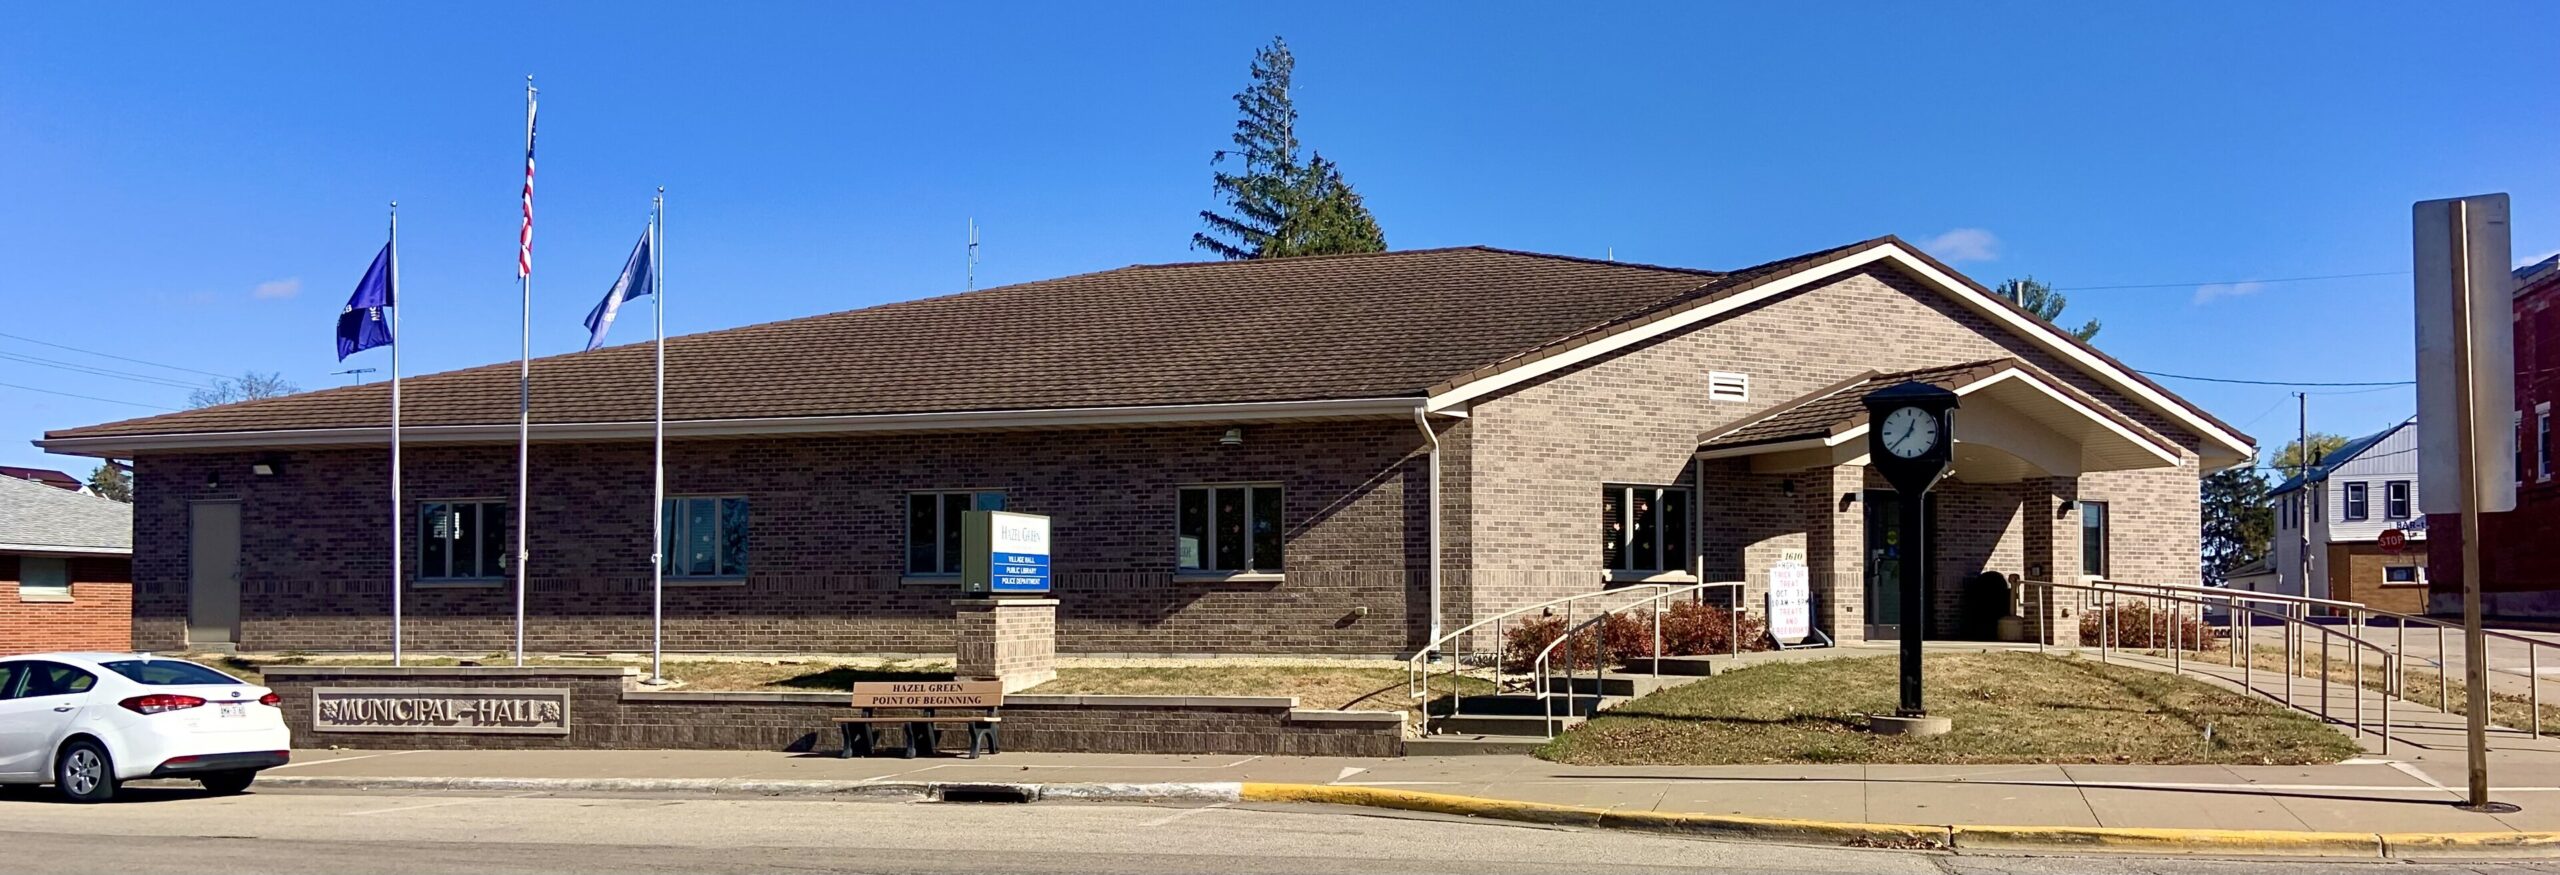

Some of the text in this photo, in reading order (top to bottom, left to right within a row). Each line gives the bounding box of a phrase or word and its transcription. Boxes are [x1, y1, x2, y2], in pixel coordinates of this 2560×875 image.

[2380, 535, 2403, 547] STOP
[1785, 552, 1803, 561] 1610
[893, 683, 964, 693] HAZEL GREEN
[872, 696, 982, 705] POINT OF BEGINNING
